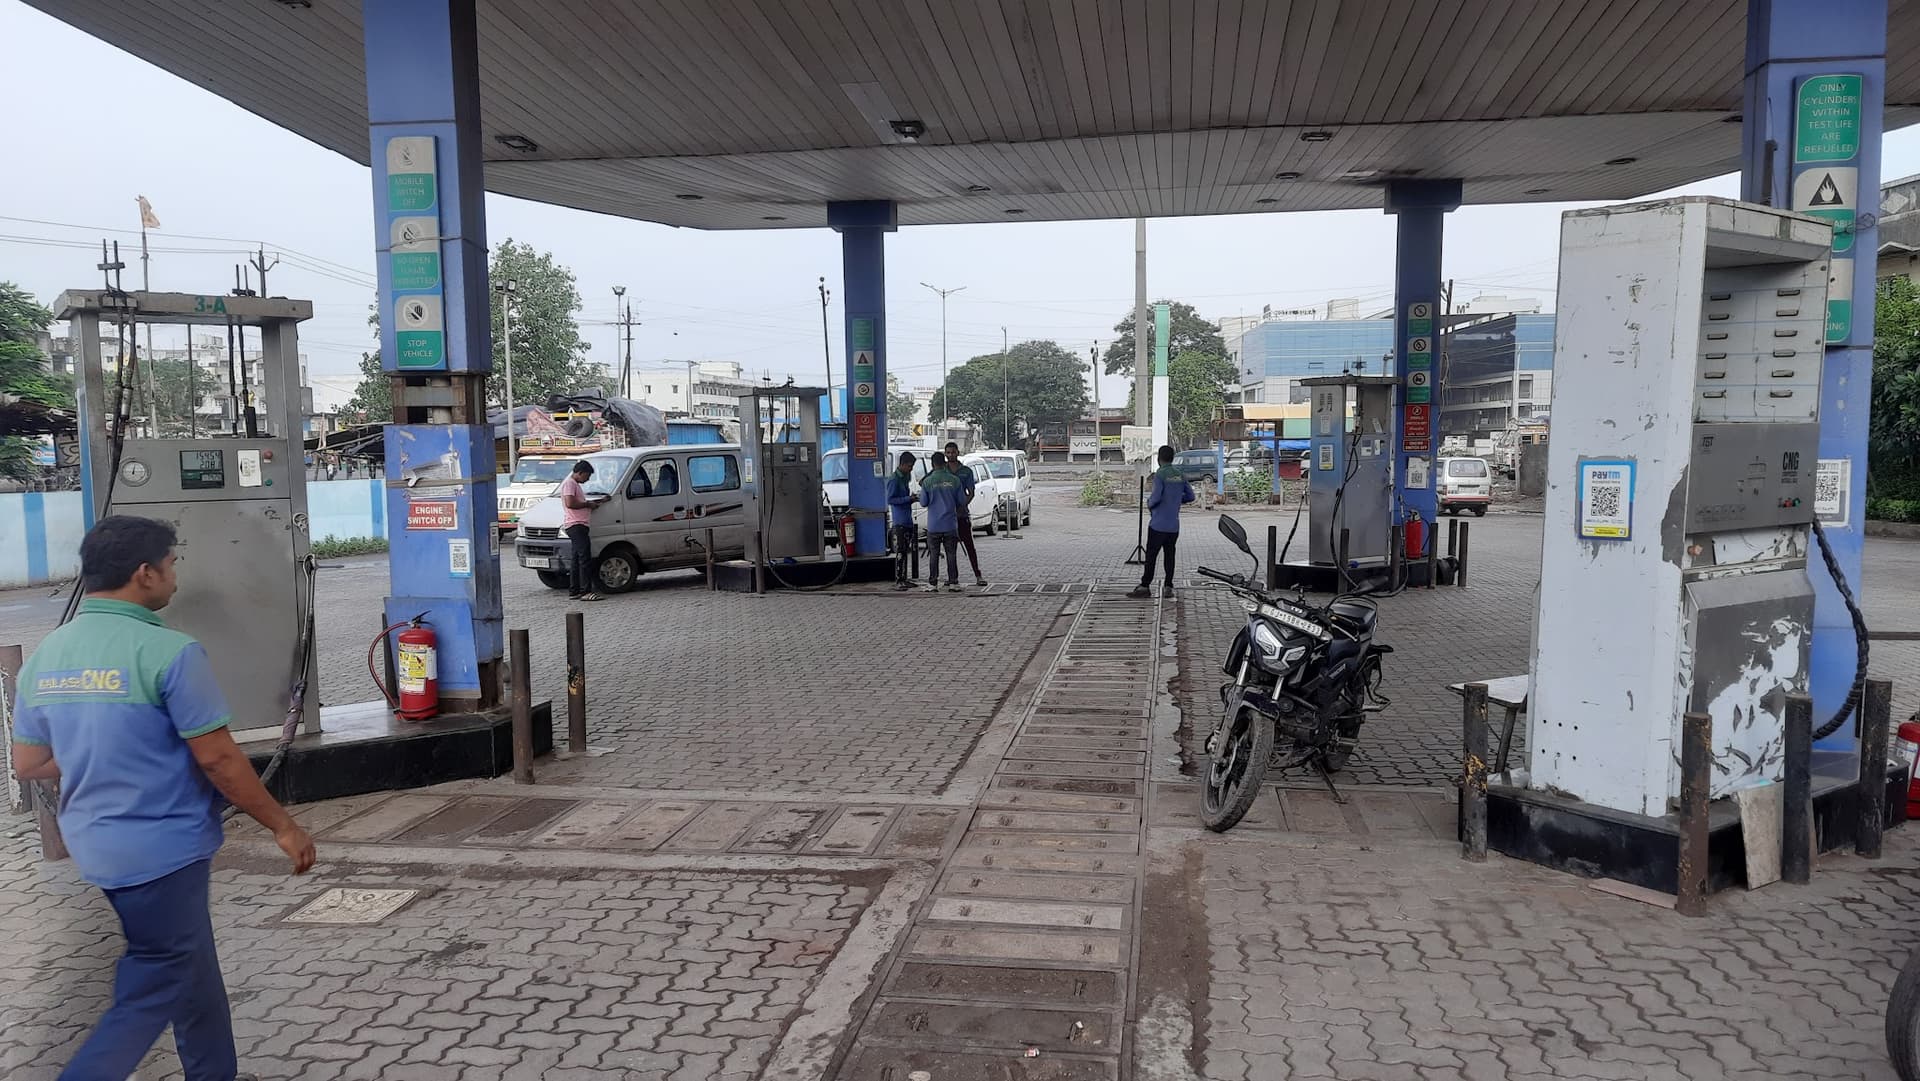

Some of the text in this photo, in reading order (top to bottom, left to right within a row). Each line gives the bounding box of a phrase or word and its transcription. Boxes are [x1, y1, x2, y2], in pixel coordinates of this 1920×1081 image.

[1819, 83, 1847, 92] ONLY
[1804, 95, 1857, 105] CYLINDERS
[1812, 108, 1850, 116] WITHIN
[1808, 120, 1853, 129] TEST LIFE
[1821, 132, 1841, 141] ARE
[1804, 144, 1853, 153] REFUELED
[194, 295, 228, 313] 3-A
[408, 339, 427, 347] STOP
[403, 350, 433, 358] VEHICLE
[1782, 451, 1800, 471] CNG
[415, 506, 443, 514] ENGINE
[407, 516, 452, 524] SWITCH OFF
[82, 669, 121, 689] CNG
